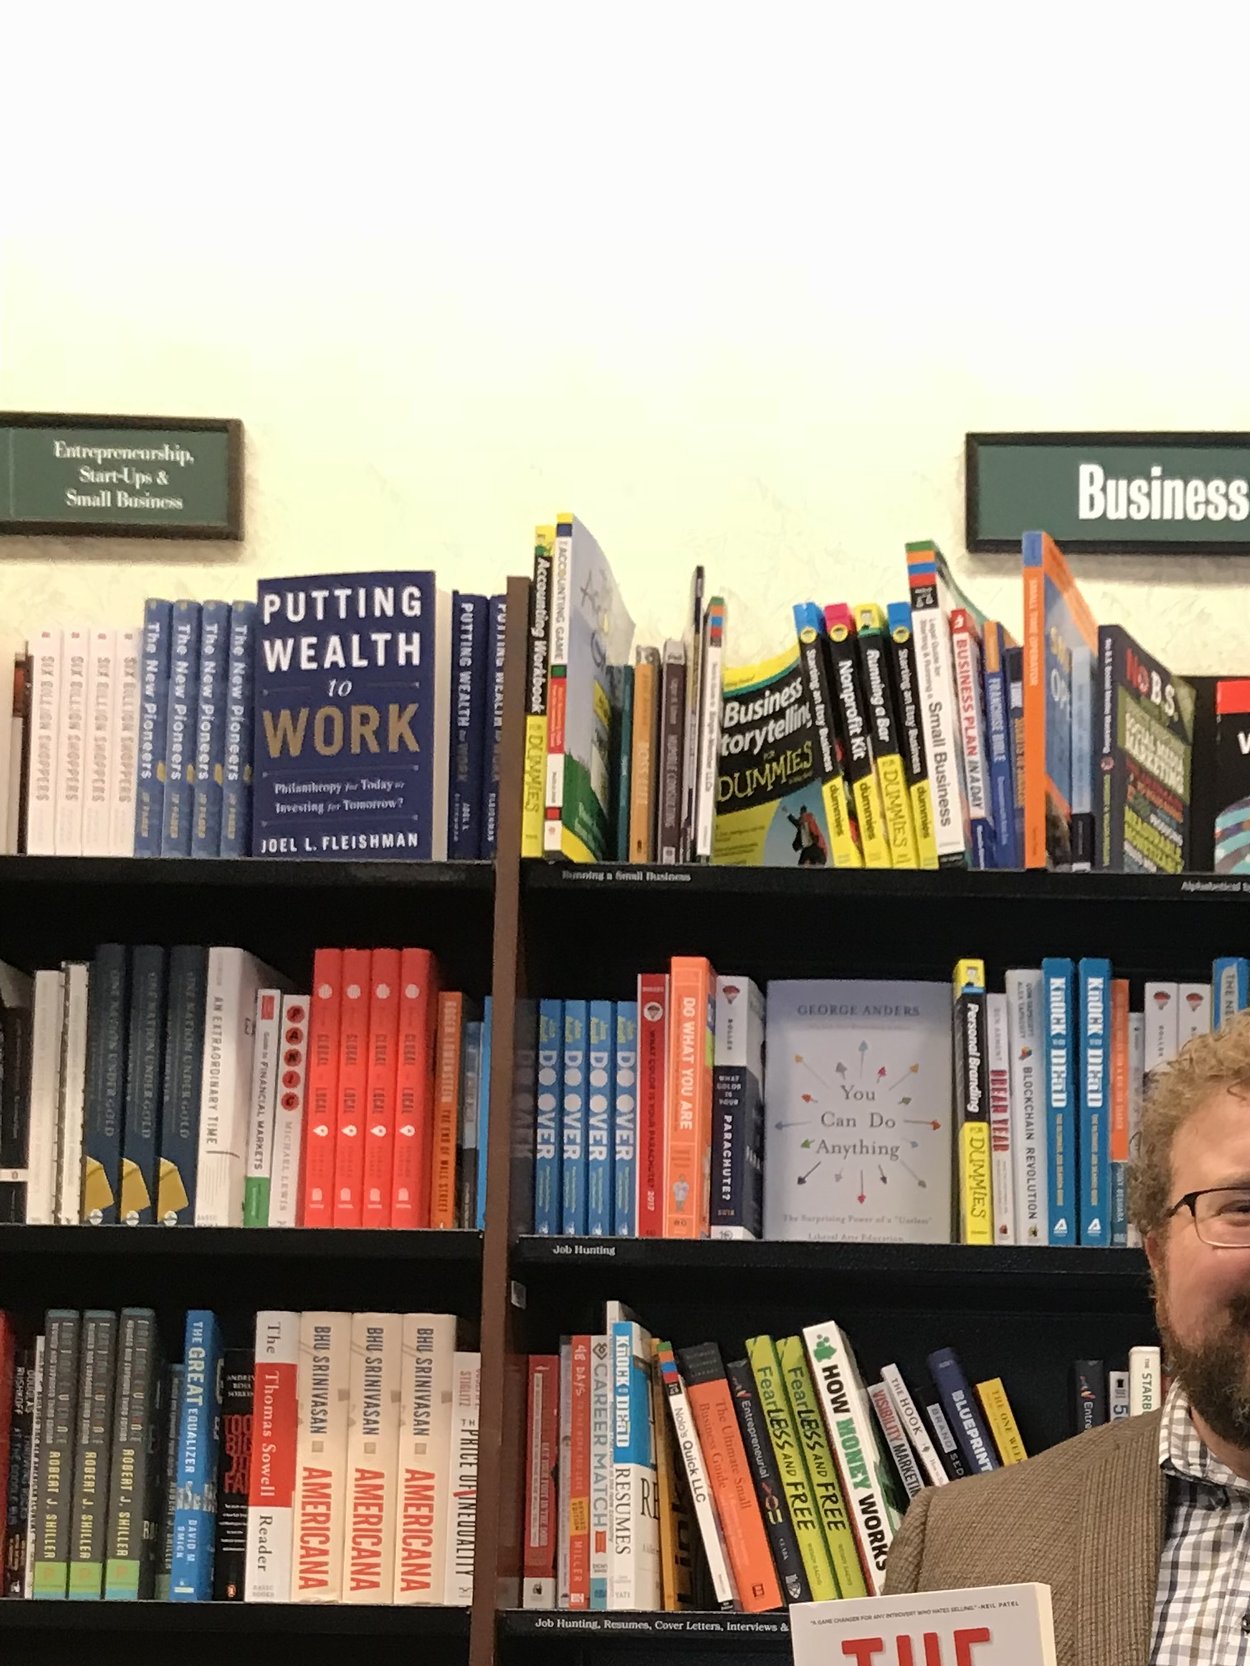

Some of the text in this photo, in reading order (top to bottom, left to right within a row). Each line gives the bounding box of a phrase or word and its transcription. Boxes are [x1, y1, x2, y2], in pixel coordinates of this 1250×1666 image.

[53, 440, 195, 465] Entrepreneurship,
[79, 466, 169, 486] Start-Ups &
[66, 490, 183, 511] Small Business
[1077, 463, 1250, 521] Business
[264, 584, 423, 624] PUTTING
[263, 632, 422, 673] WEALTH
[262, 703, 420, 758] WORK
[261, 831, 418, 854] JOEL L. FLEISHMAN
[615, 871, 643, 881] Small
[646, 871, 692, 882] Business
[797, 1004, 920, 1018] GEORGE ANDERS
[680, 997, 696, 1130] DO WHAT YOU ARE
[842, 1084, 876, 1101] You
[821, 1112, 896, 1129] Can Do
[816, 1139, 900, 1160] Anything
[553, 1245, 615, 1257] Job Hunting
[257, 1322, 282, 1573] The Thomas Sowell Reader
[821, 1365, 888, 1571] HOW MONEY WORKS
[299, 1468, 333, 1590] AMERICANA
[535, 1618, 788, 1633] Job Hunting, Resumes, Cover Letters, Interviews &
